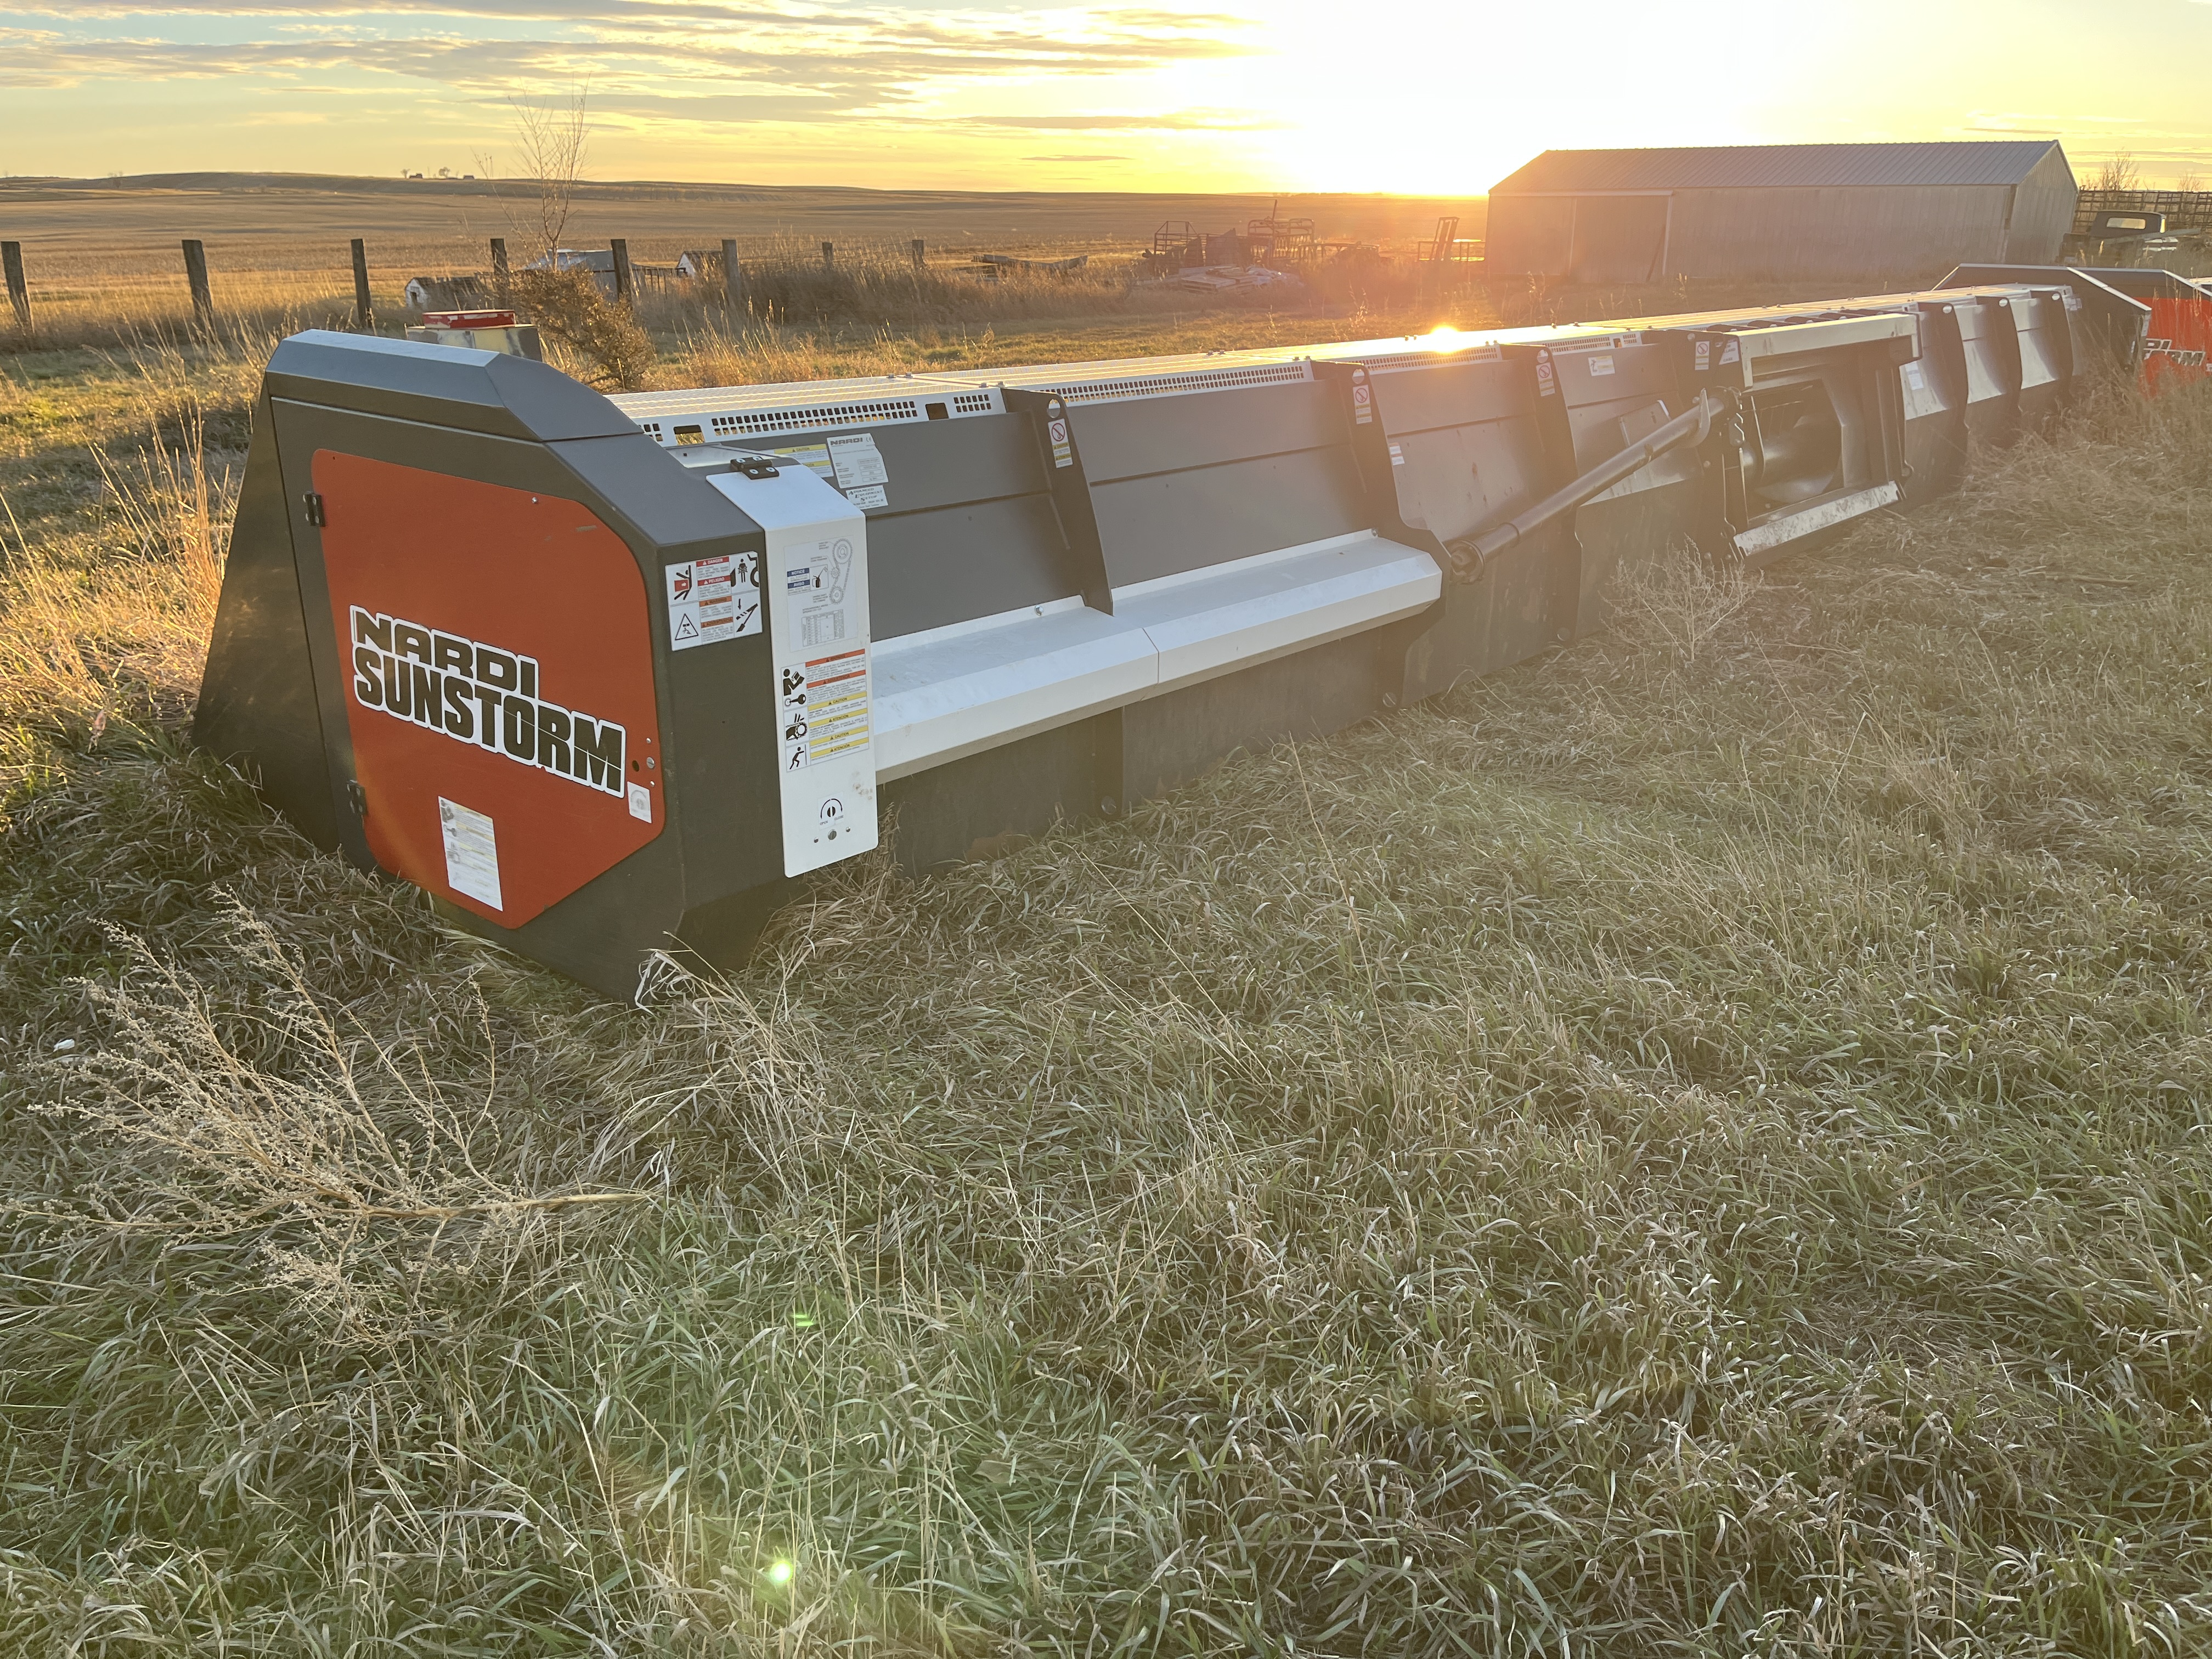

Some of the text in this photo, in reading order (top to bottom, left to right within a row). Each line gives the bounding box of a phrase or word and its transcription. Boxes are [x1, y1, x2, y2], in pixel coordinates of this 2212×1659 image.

[830, 437, 864, 445] NARDI
[855, 490, 883, 499] EQUIPMENT
[351, 605, 539, 699] NARDI
[354, 645, 625, 795] SUNSTORM
